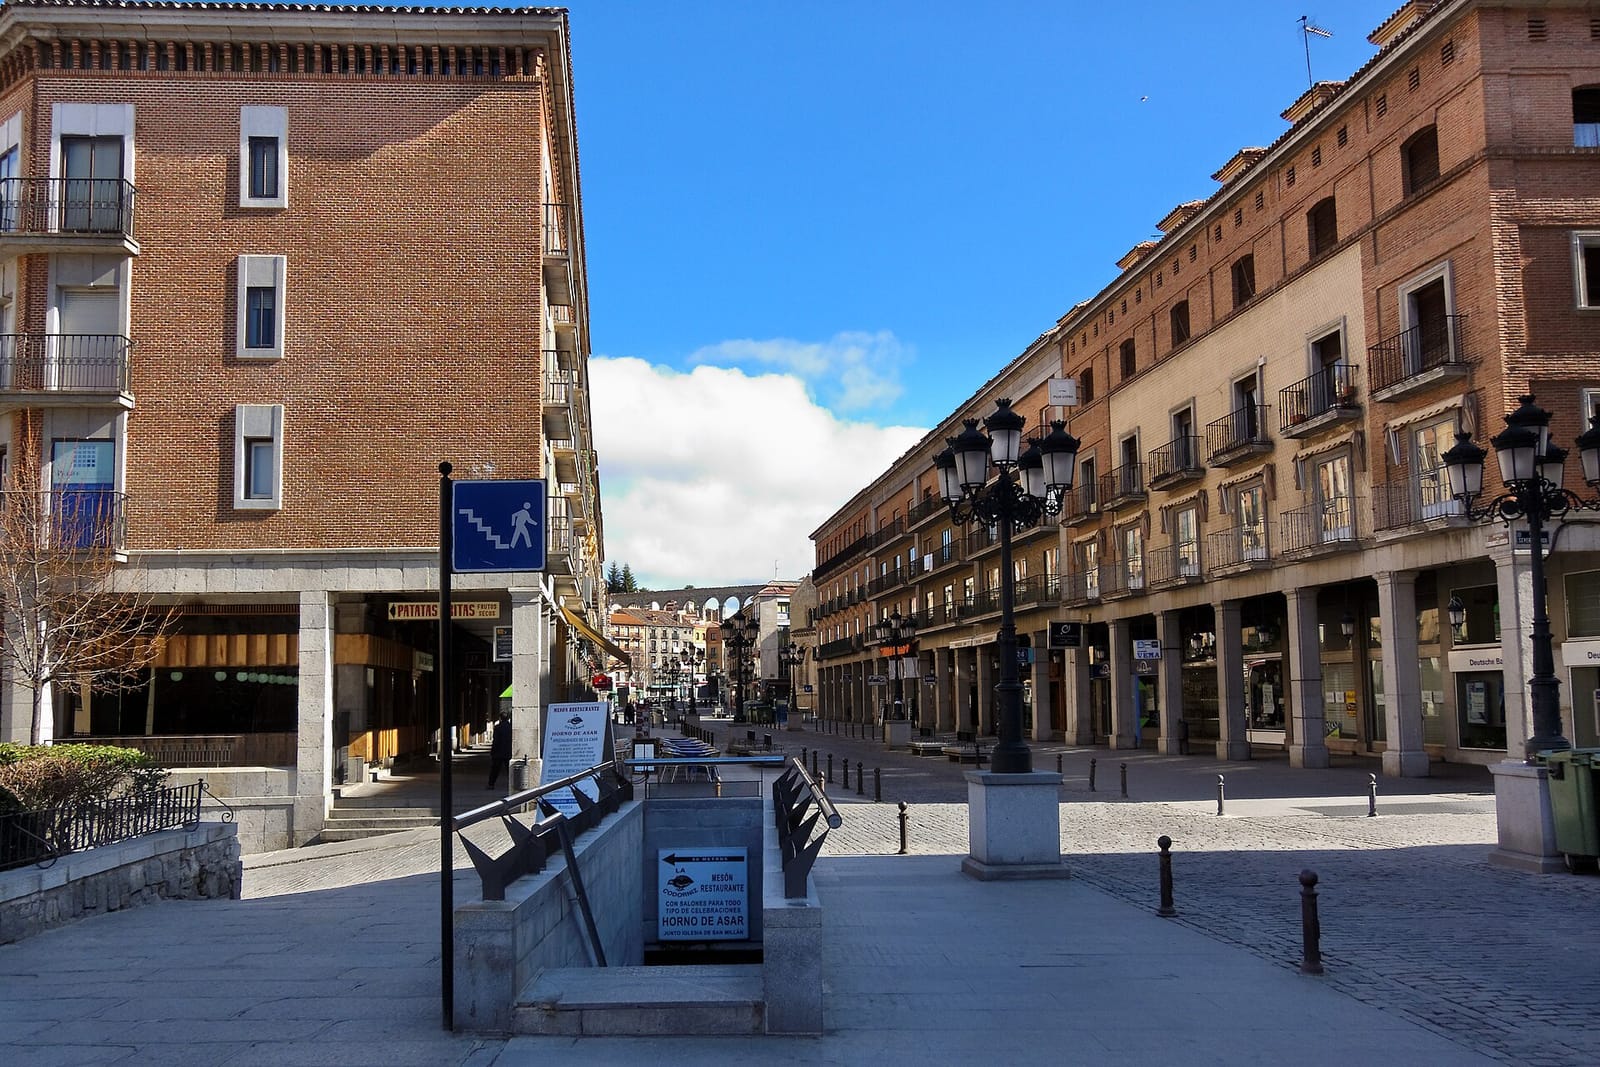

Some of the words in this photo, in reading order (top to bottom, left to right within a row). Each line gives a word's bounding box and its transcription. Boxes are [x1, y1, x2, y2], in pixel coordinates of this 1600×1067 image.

[398, 604, 438, 617] PATATAS
[711, 872, 734, 882] MESÓN
[662, 888, 698, 898] CODORNIZ
[700, 884, 744, 892] RESTAURANTE
[662, 916, 698, 926] HORNO
[701, 916, 714, 926] DE
[716, 915, 744, 926] ASAR
